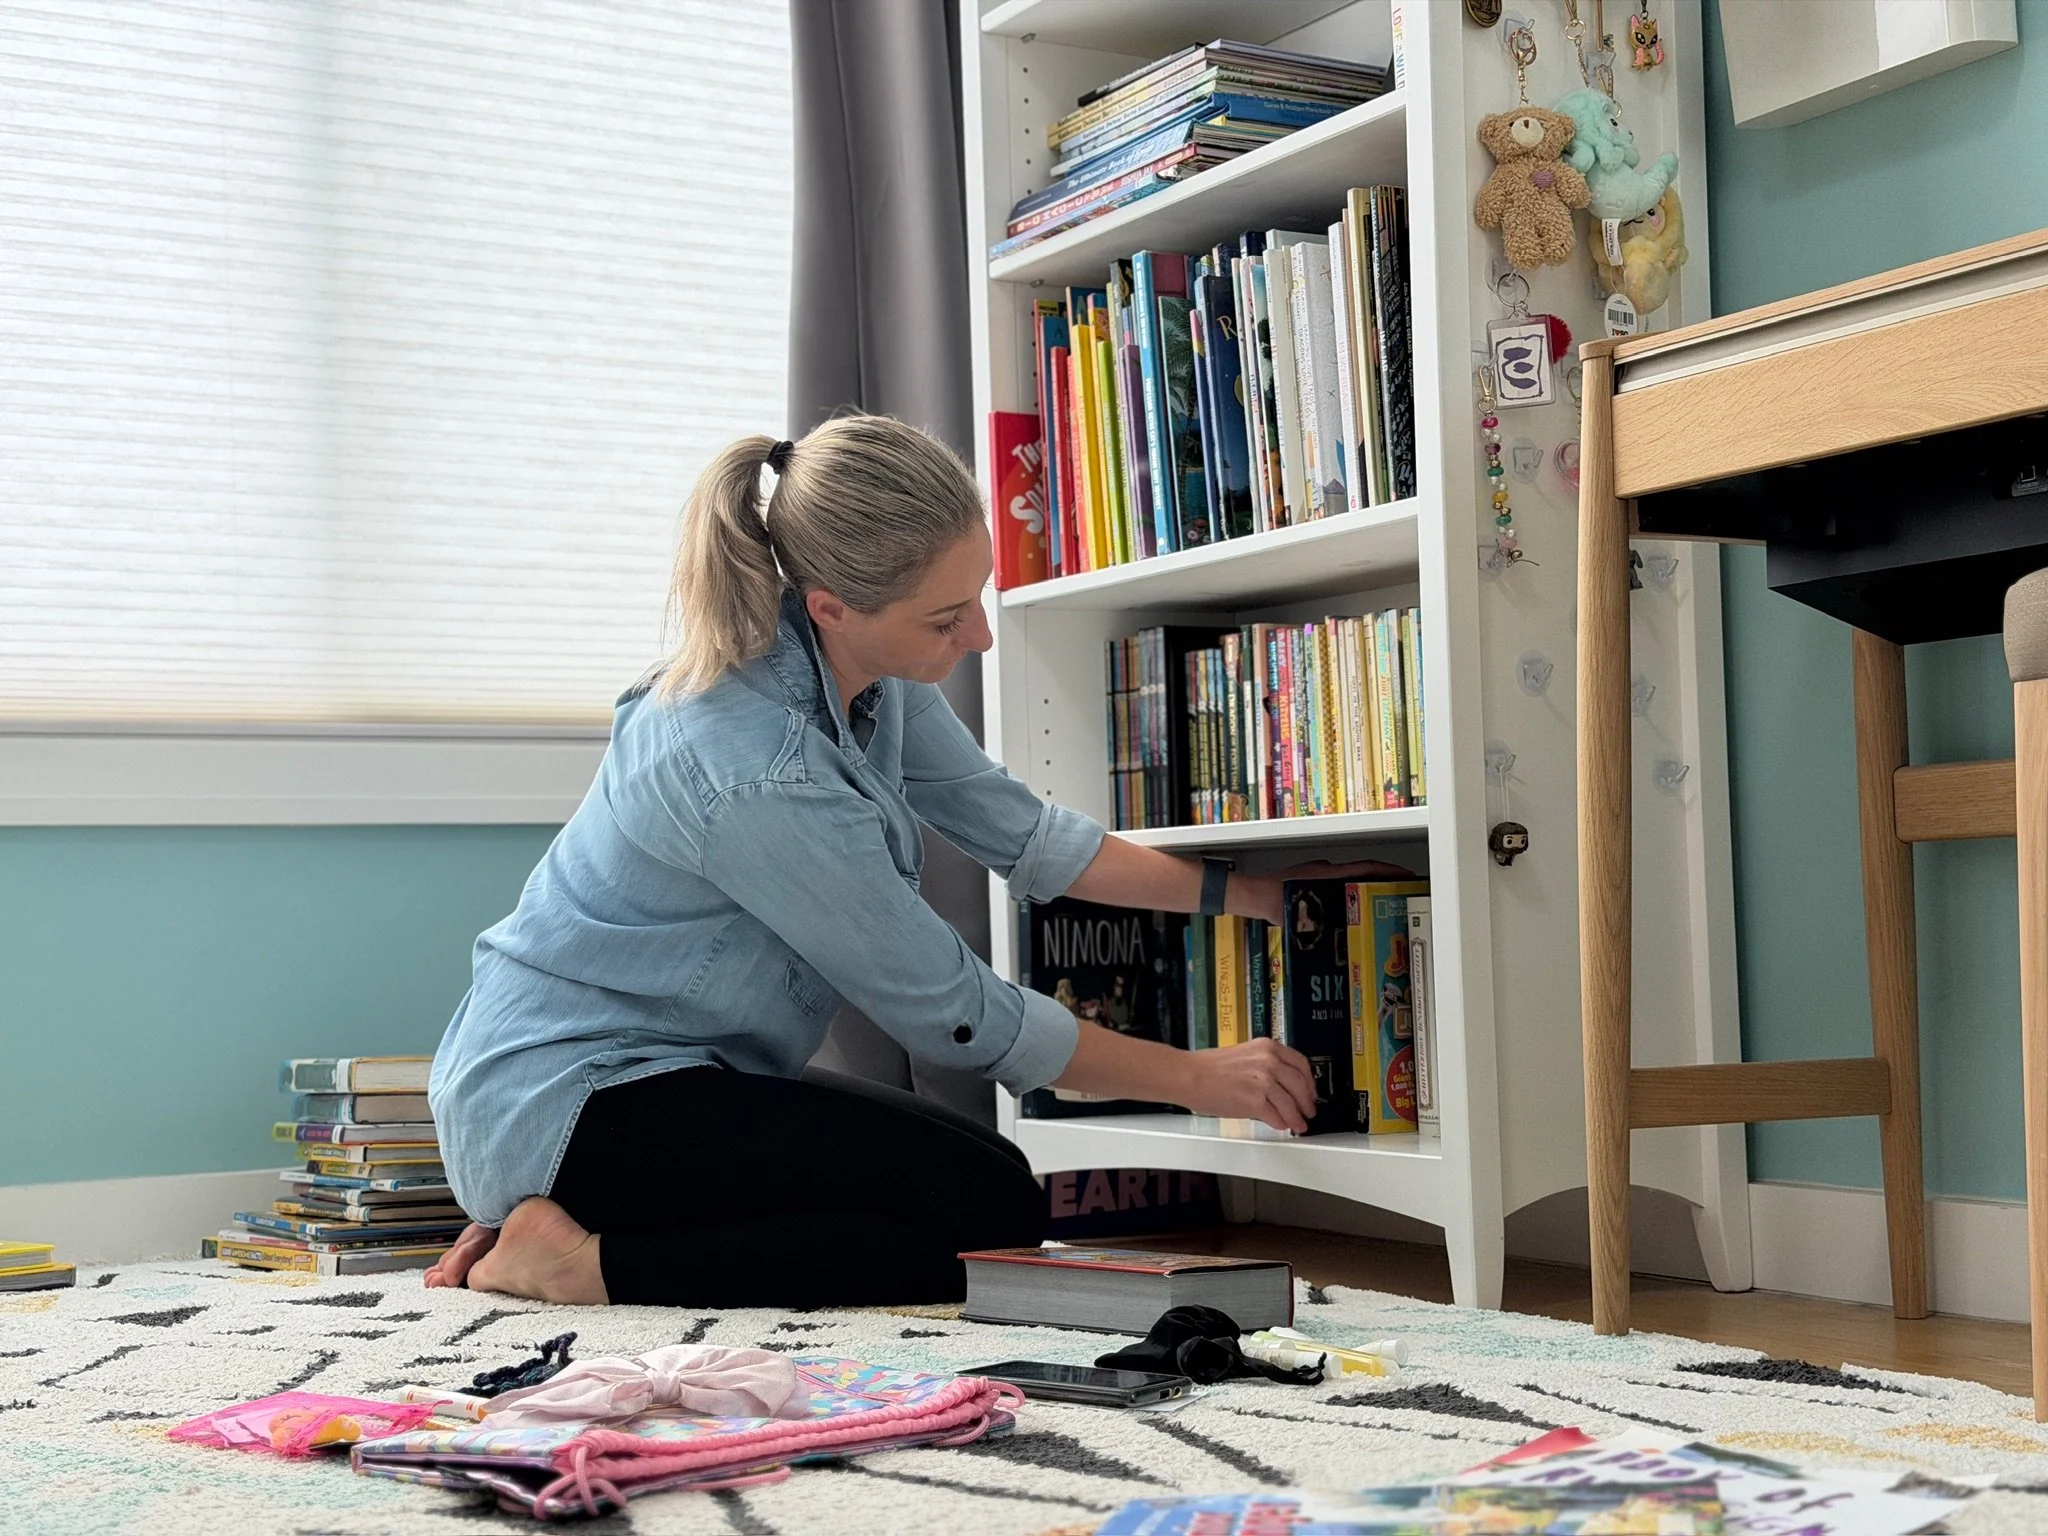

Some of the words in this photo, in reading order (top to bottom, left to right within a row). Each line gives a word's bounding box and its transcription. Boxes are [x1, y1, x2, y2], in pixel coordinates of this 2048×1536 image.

[1297, 327, 1305, 363] DRAGONS
[1380, 352, 1388, 371] JAR
[1226, 692, 1237, 737] DRAGON
[1278, 693, 1289, 742] KITTENS
[1229, 746, 1239, 791] FORTUNE
[1273, 759, 1281, 773] PIP
[1274, 775, 1282, 797] BIRD
[1043, 915, 1146, 968] NIMONA
[1217, 953, 1232, 994] WINGS
[1250, 951, 1264, 993] WINGS
[1310, 975, 1345, 1003] SIX
[1219, 1003, 1233, 1032] FIRE
[1253, 1002, 1266, 1032] FIRE
[1396, 1097, 1410, 1109] Big
[1050, 1168, 1211, 1219] EARTH
